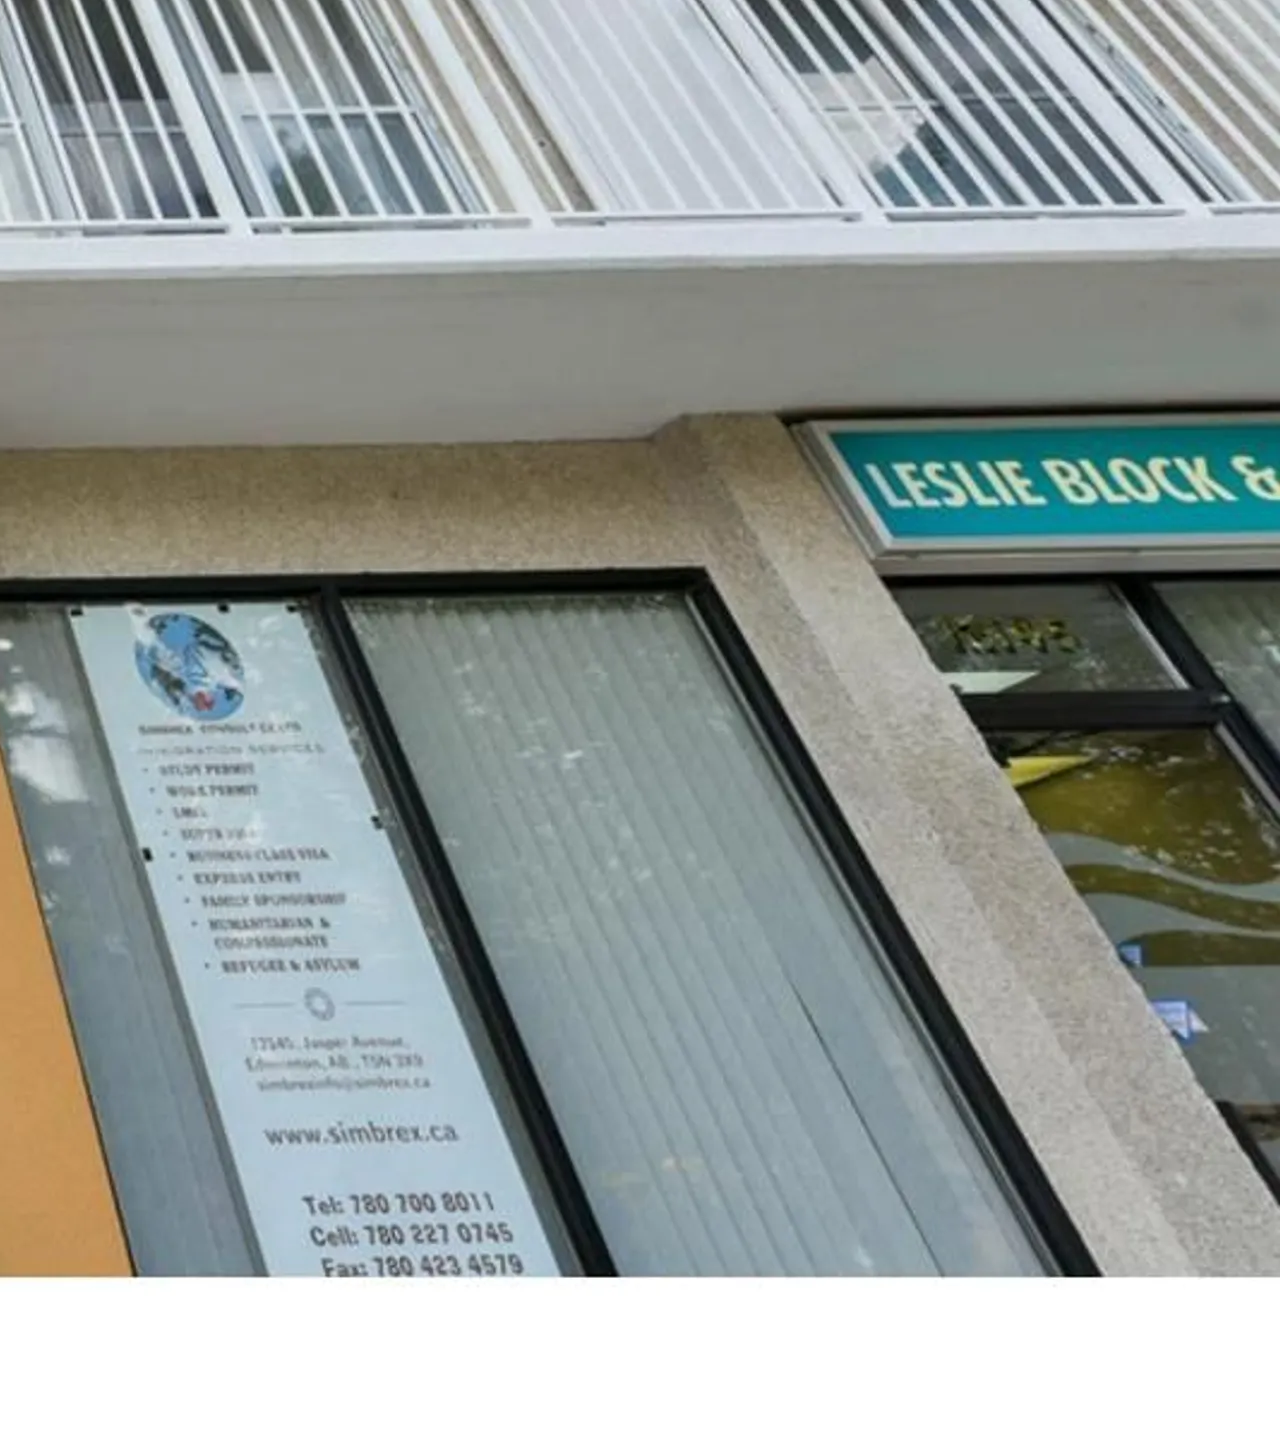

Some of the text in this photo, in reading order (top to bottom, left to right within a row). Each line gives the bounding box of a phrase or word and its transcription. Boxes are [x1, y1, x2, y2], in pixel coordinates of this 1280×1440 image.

[865, 454, 1280, 508] LESLIE BLOCK &
[304, 957, 361, 972] ASYLUM
[263, 1121, 459, 1145] www.simbrex.ca
[302, 1191, 495, 1216] Tel: 780 700 8011
[309, 1222, 514, 1247] Cell: 780 227 0745
[321, 1254, 524, 1277] Fax: 780 423 4579
